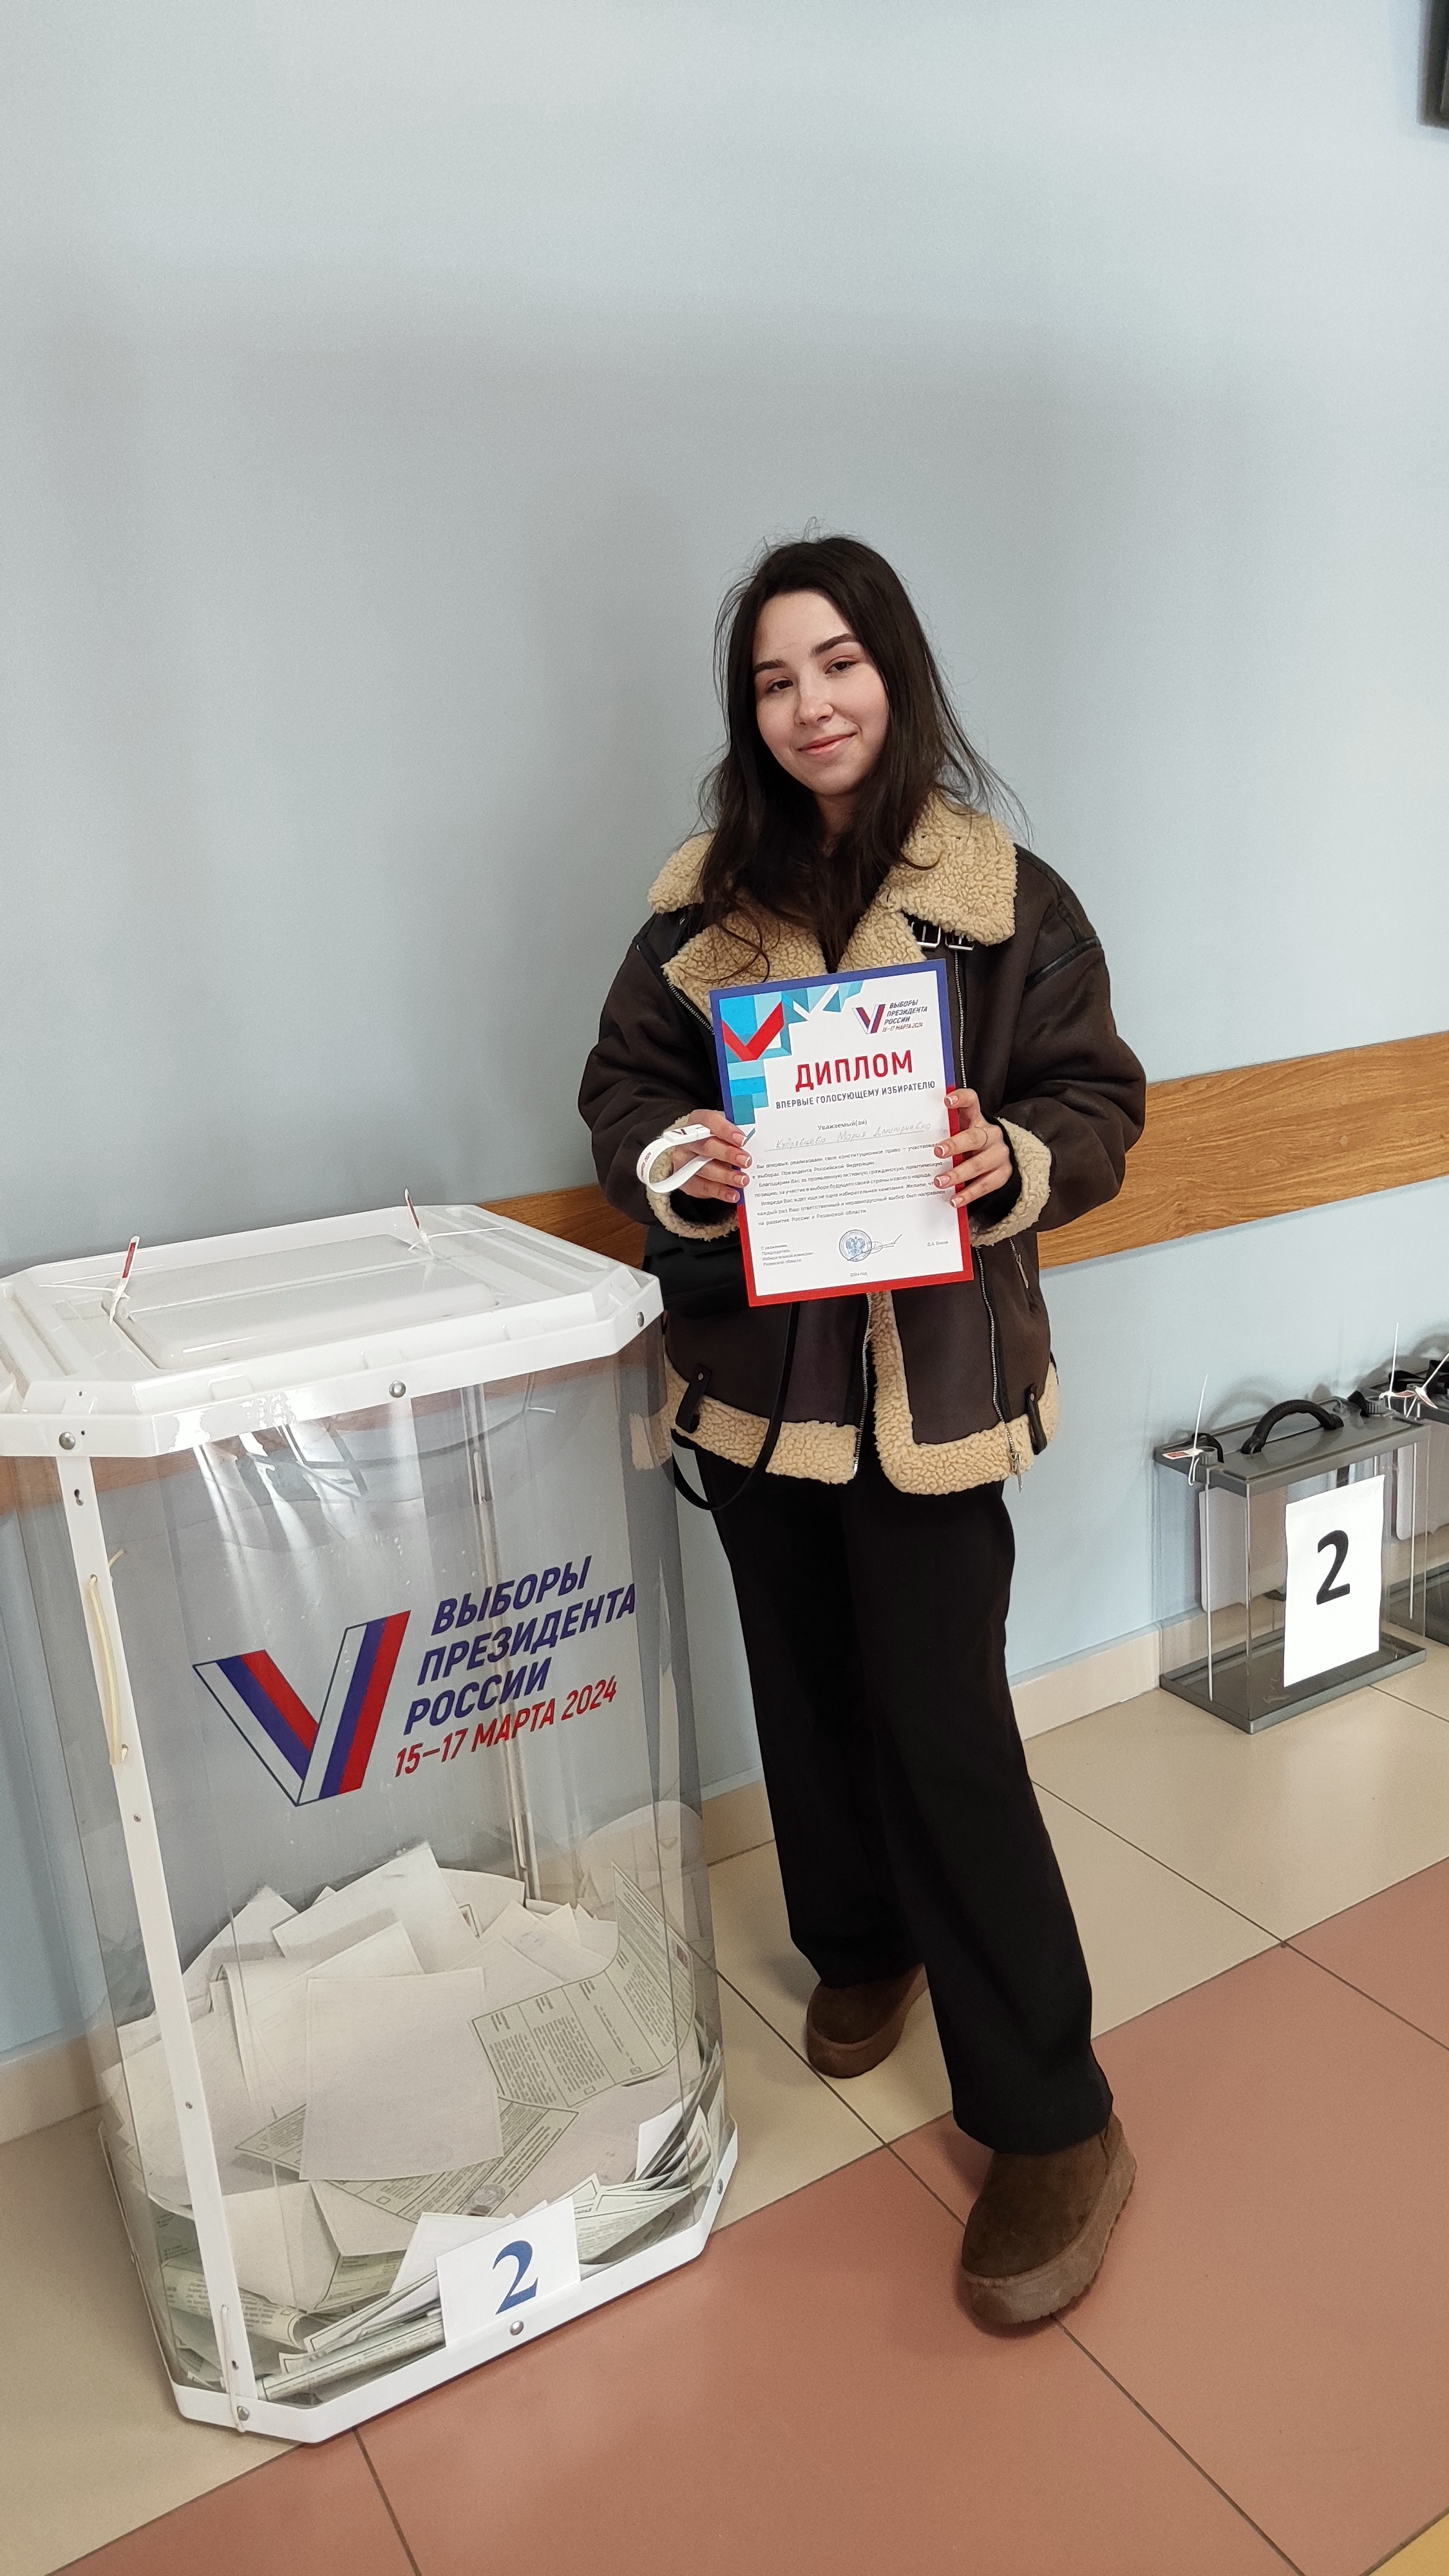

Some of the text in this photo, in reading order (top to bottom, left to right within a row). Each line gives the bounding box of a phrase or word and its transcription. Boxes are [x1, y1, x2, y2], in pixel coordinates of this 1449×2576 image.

[884, 1016, 911, 1025] РОССИИ
[887, 1006, 928, 1017] ПРЕЗИДЕНТА
[889, 999, 919, 1009] ВЫБОРЫ
[775, 1081, 935, 1109] ВПЕРВЫЕ ГОЛОСУЮЩЕМУ ИЗБИРАТЕЛЮ
[795, 1049, 913, 1093] ДИПЛОМ
[431, 1555, 592, 1636] ВЫБОРЫ
[1316, 1529, 1350, 1605] 2
[417, 1582, 636, 1686] ПРЕЗИДЕНТА
[404, 1657, 552, 1736] РОССИИ
[471, 1698, 556, 1752] МАРТА
[561, 1674, 617, 1721] 2024
[491, 2240, 539, 2316] 2
